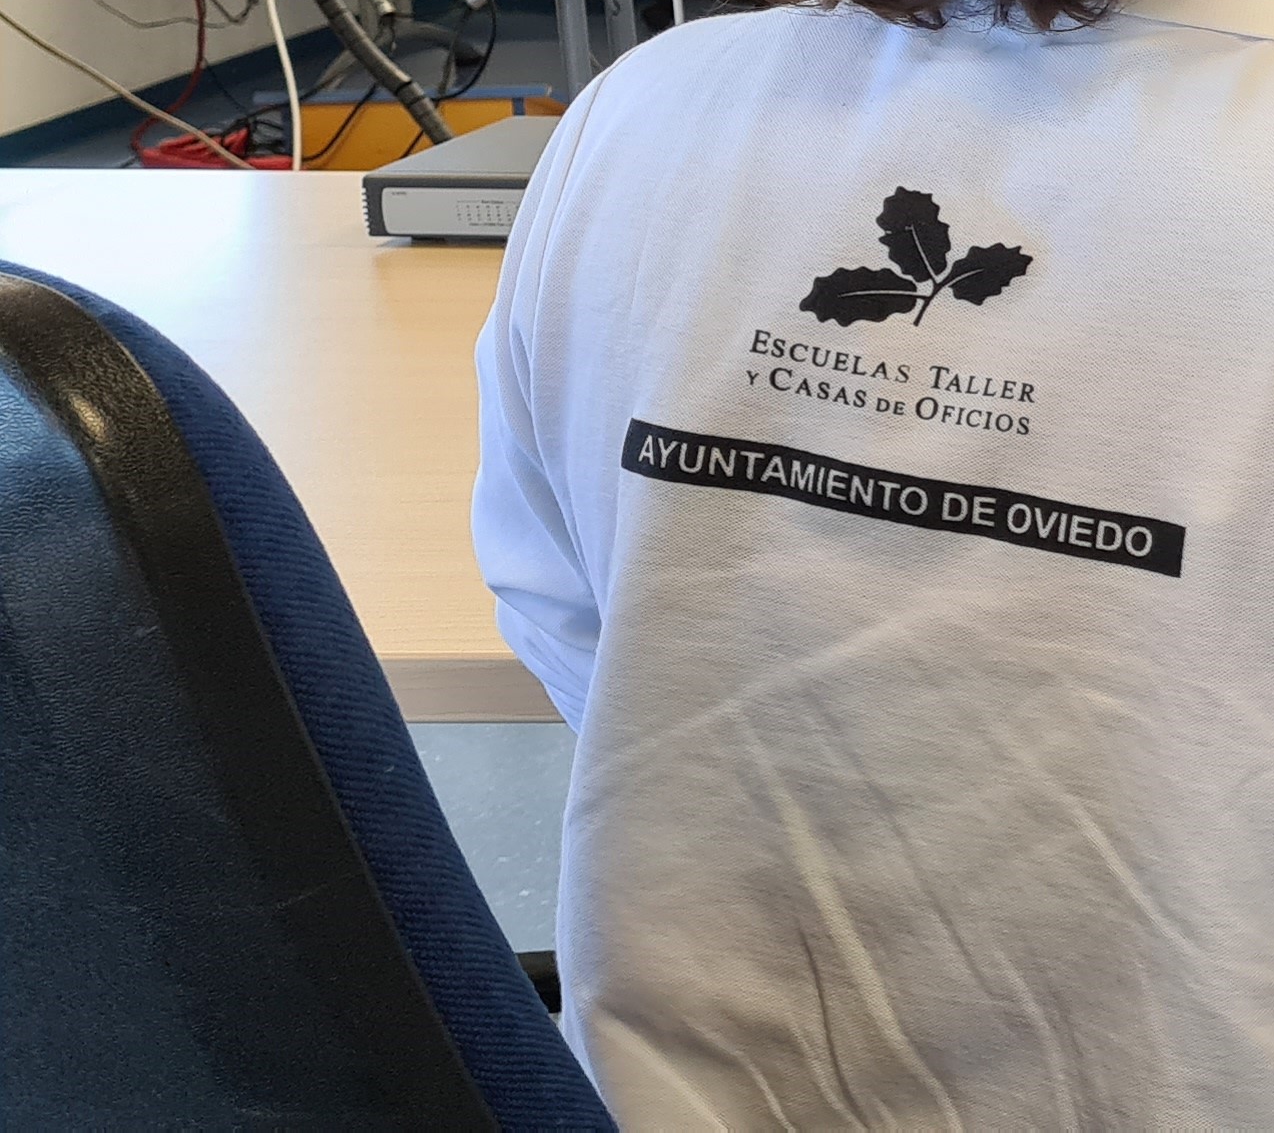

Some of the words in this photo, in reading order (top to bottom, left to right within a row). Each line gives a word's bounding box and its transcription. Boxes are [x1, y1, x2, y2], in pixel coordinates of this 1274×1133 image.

[749, 329, 911, 383] ESCUELAS
[929, 365, 1036, 403] TALLER
[769, 367, 867, 408] CASAS
[876, 398, 906, 416] DE
[915, 396, 1031, 436] OFICIOS
[638, 435, 929, 516] AYUNTAMIENTO
[942, 492, 997, 529] DE
[1006, 503, 1154, 559] OVIEDO
